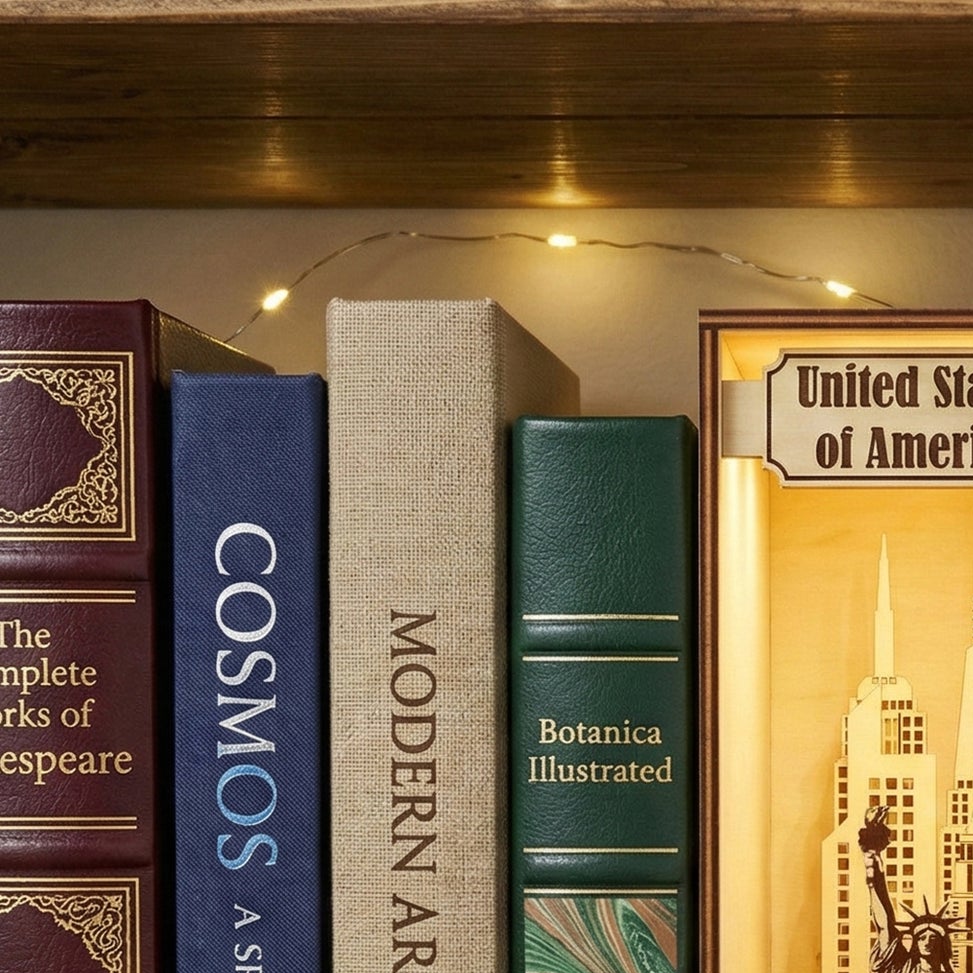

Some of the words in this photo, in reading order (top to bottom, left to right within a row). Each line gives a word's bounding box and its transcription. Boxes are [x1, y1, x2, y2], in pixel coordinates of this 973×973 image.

[797, 363, 919, 408] United
[815, 425, 853, 469] of
[0, 619, 51, 648] The
[214, 522, 279, 871] COSMOS
[0, 699, 51, 728] rks
[60, 698, 96, 728] of
[390, 610, 437, 875] MODERN
[538, 718, 663, 747] Botanica
[527, 756, 673, 784] Illustrated
[234, 903, 261, 929] A
